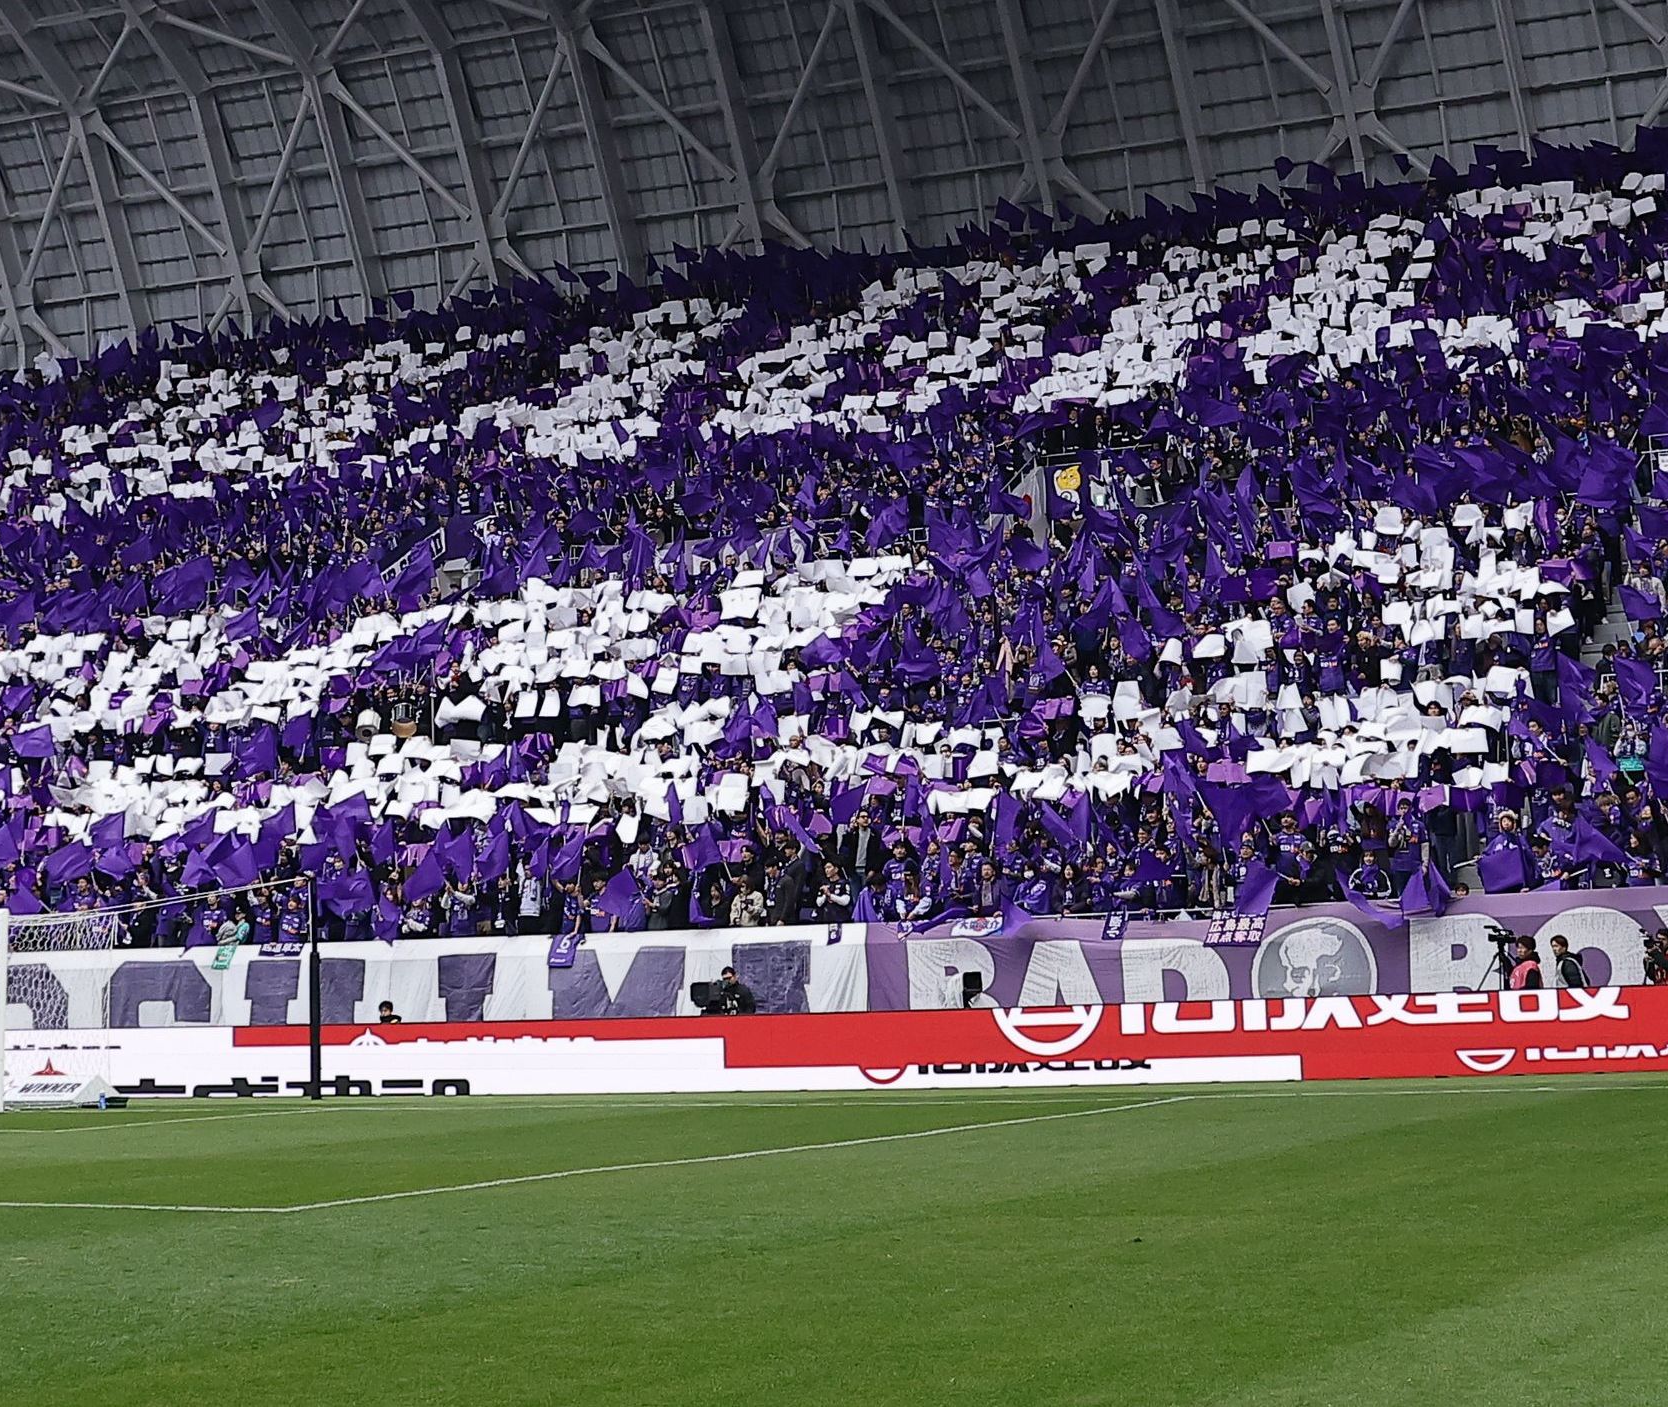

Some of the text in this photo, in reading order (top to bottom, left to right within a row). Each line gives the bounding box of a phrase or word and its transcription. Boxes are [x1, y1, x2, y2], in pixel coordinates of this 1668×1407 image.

[560, 934, 570, 949] 6
[906, 938, 1230, 1011] BAD
[18, 1082, 83, 1094] WINNER
